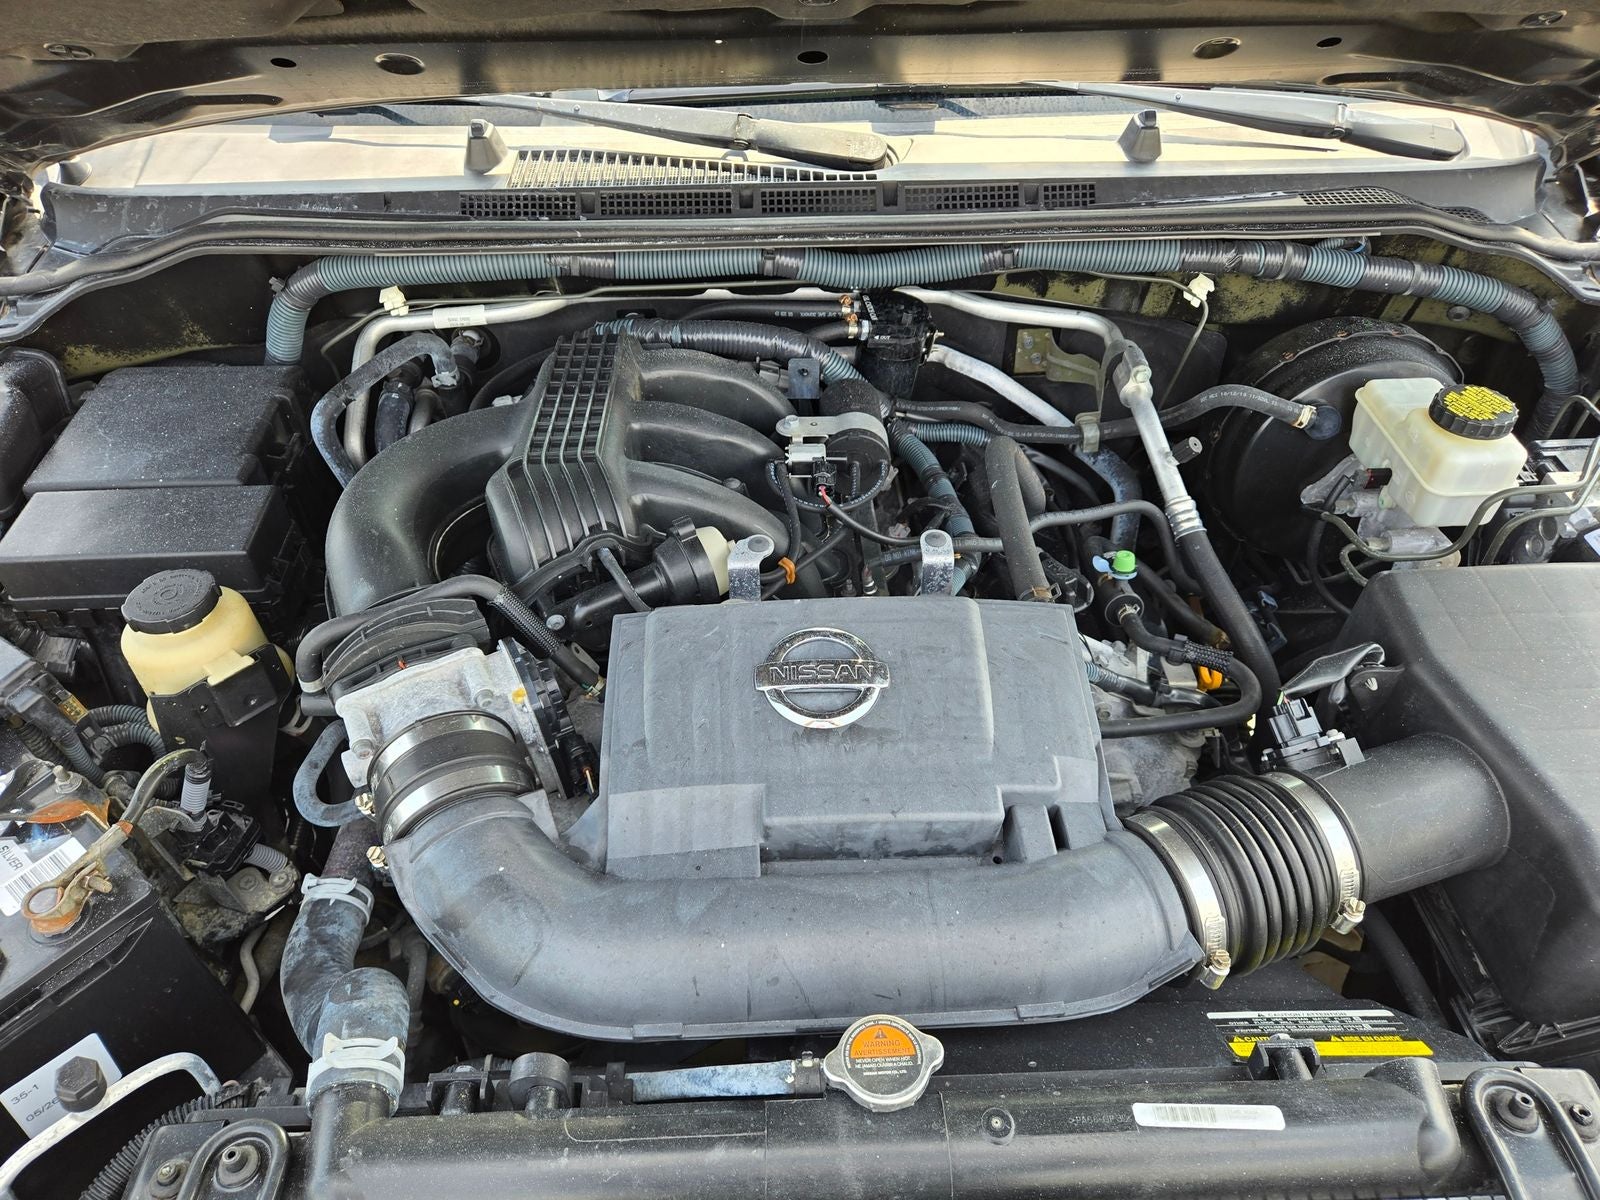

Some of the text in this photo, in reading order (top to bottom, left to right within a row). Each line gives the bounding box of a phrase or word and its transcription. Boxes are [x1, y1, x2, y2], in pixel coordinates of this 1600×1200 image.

[769, 664, 874, 681] NISSAN
[0, 845, 24, 871] SILVER
[855, 1048, 911, 1056] AVERTISSEMENT
[863, 1039, 900, 1048] WARNING
[11, 1083, 39, 1105] 35-1
